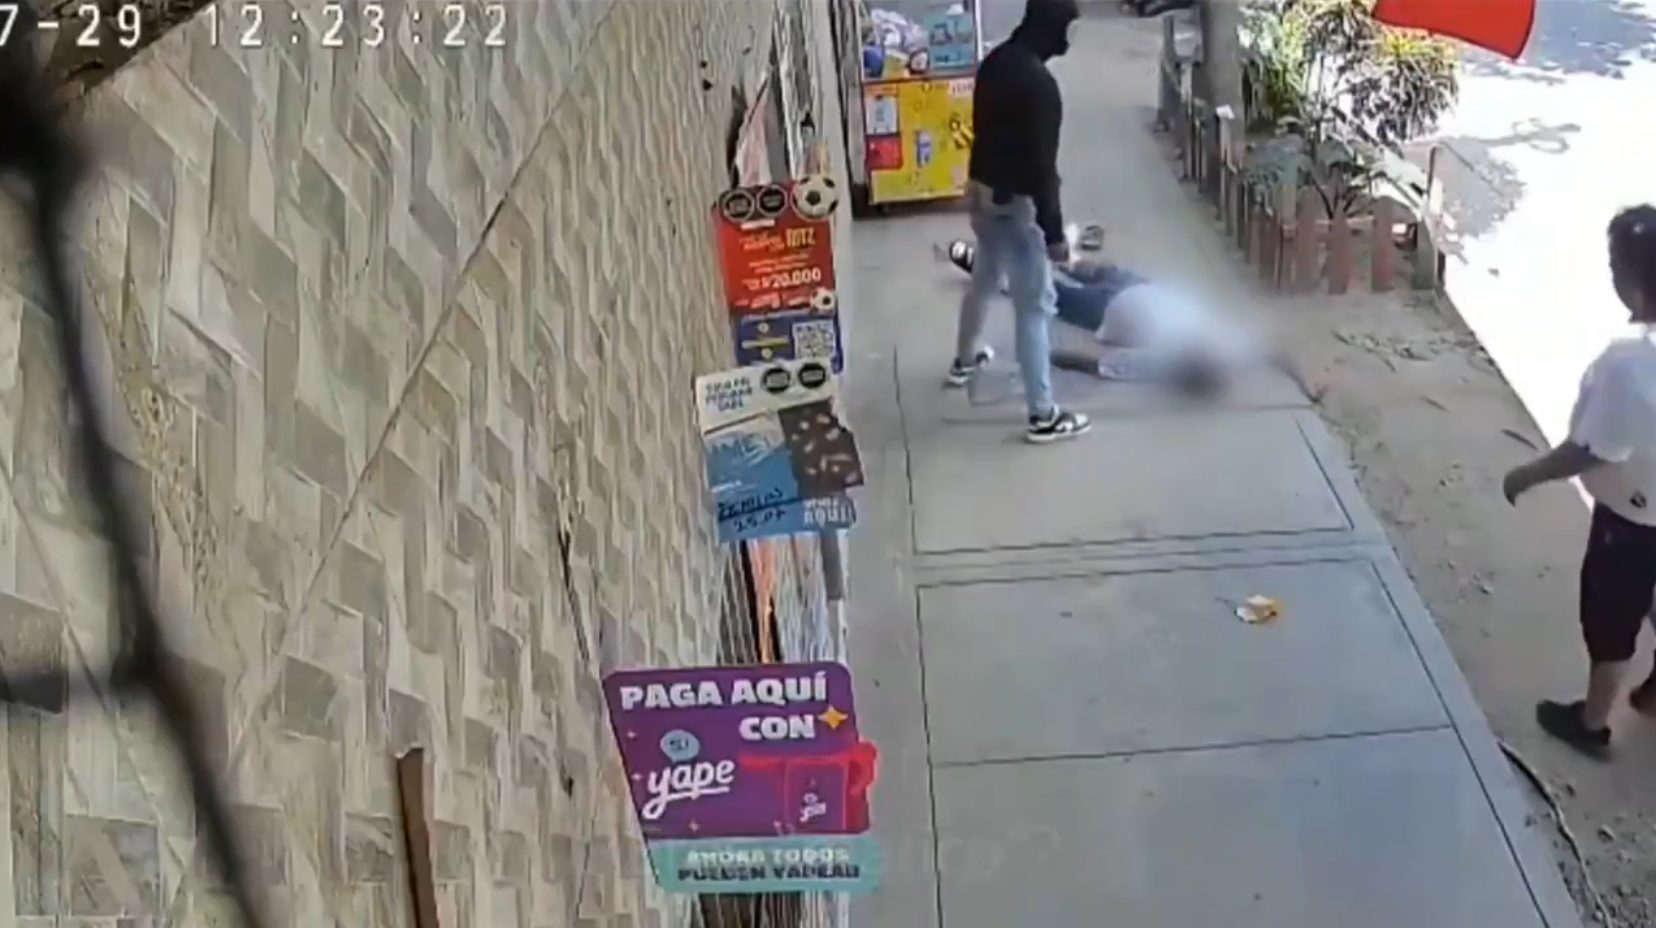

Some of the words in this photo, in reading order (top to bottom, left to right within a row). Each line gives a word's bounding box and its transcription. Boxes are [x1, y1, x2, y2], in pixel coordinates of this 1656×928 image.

[619, 681, 723, 710] PAGA
[731, 671, 827, 705] AQUÍ
[739, 714, 816, 741] CON
[641, 759, 735, 820] yape
